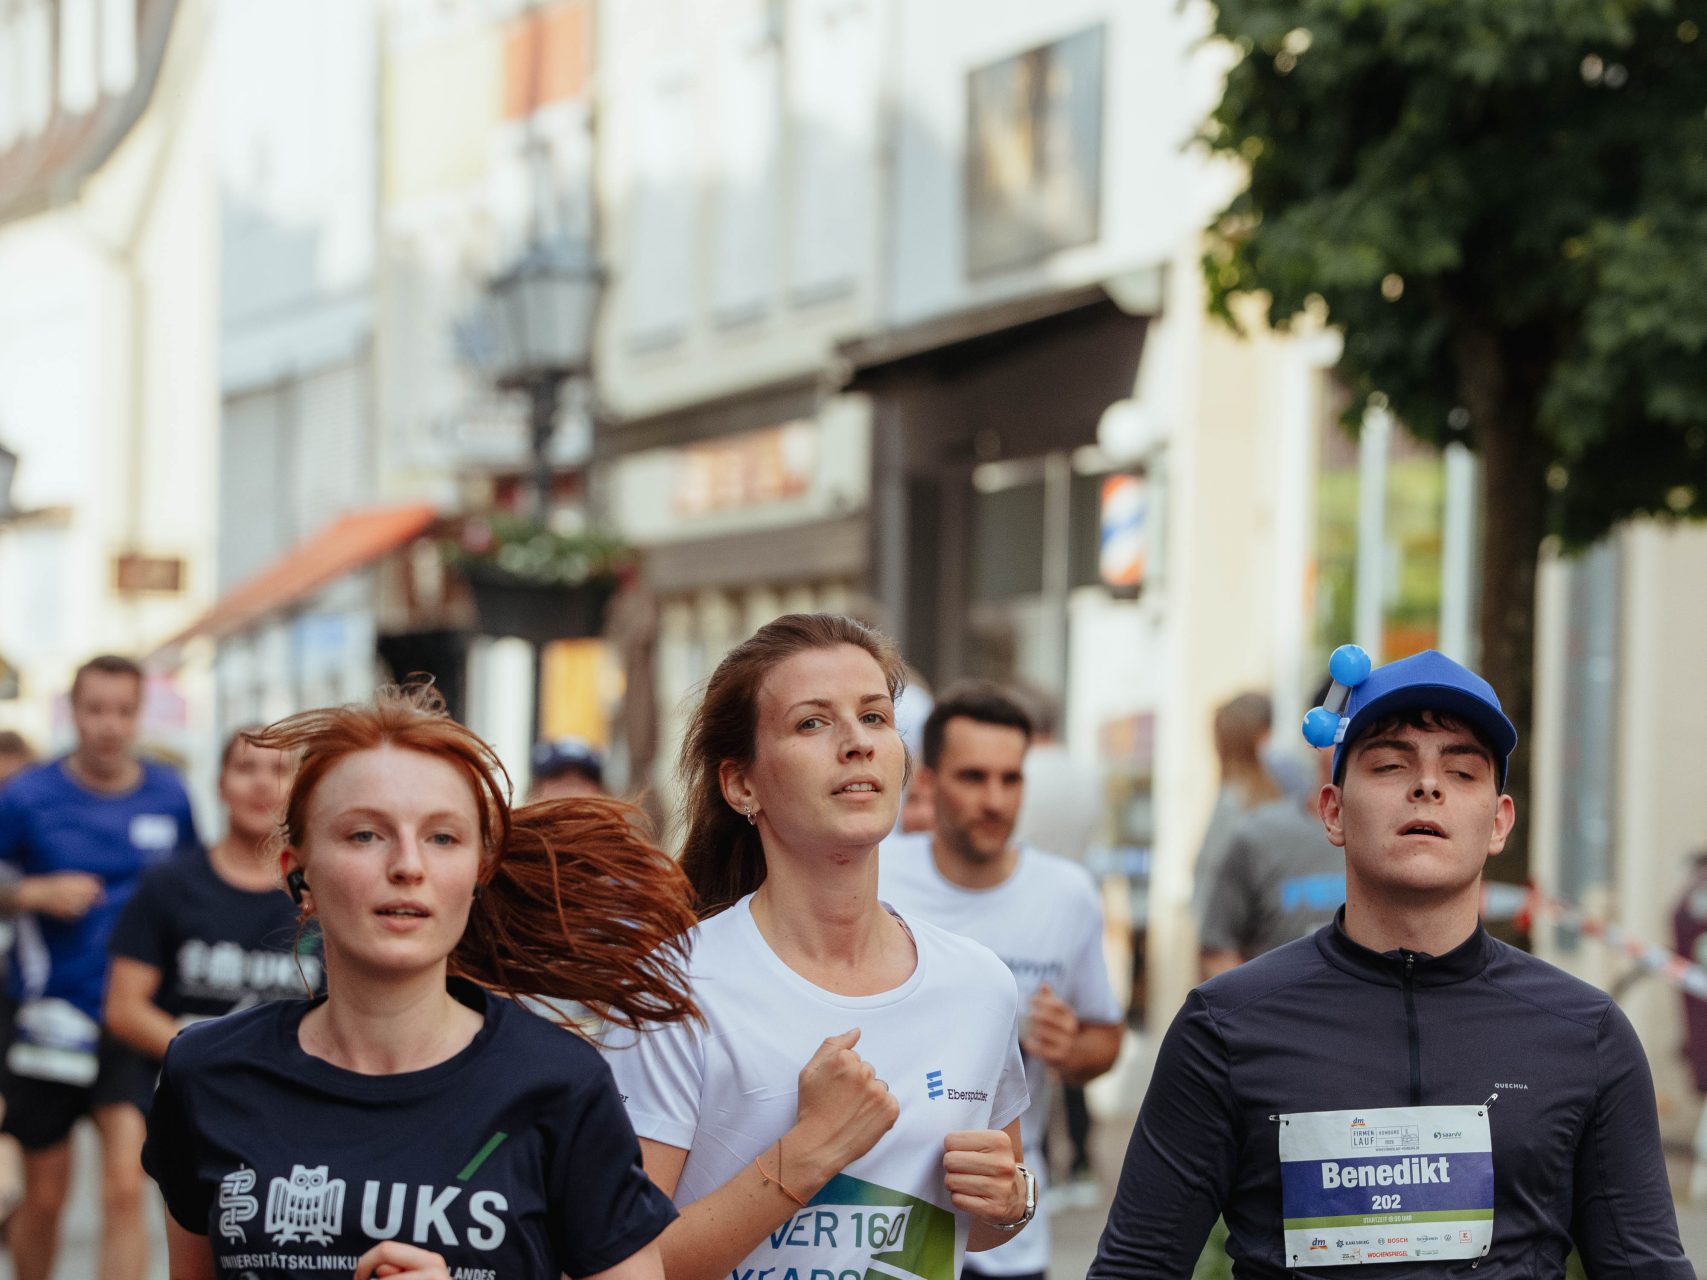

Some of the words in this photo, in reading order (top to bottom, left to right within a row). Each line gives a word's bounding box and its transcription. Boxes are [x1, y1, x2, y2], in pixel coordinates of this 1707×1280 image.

[1494, 1082, 1529, 1090] QUECHUA
[1353, 1136, 1375, 1146] LAUF
[1321, 1156, 1450, 1190] Benedikt
[1371, 1194, 1402, 1210] 202
[361, 1180, 509, 1251] UKS
[768, 1211, 839, 1250] VER
[850, 1212, 906, 1250] 160
[1312, 1237, 1326, 1247] dm
[220, 1252, 360, 1271] UNIVERSITÄTSKLINIKU
[1367, 1250, 1408, 1258] WOCHENSPIEGEL
